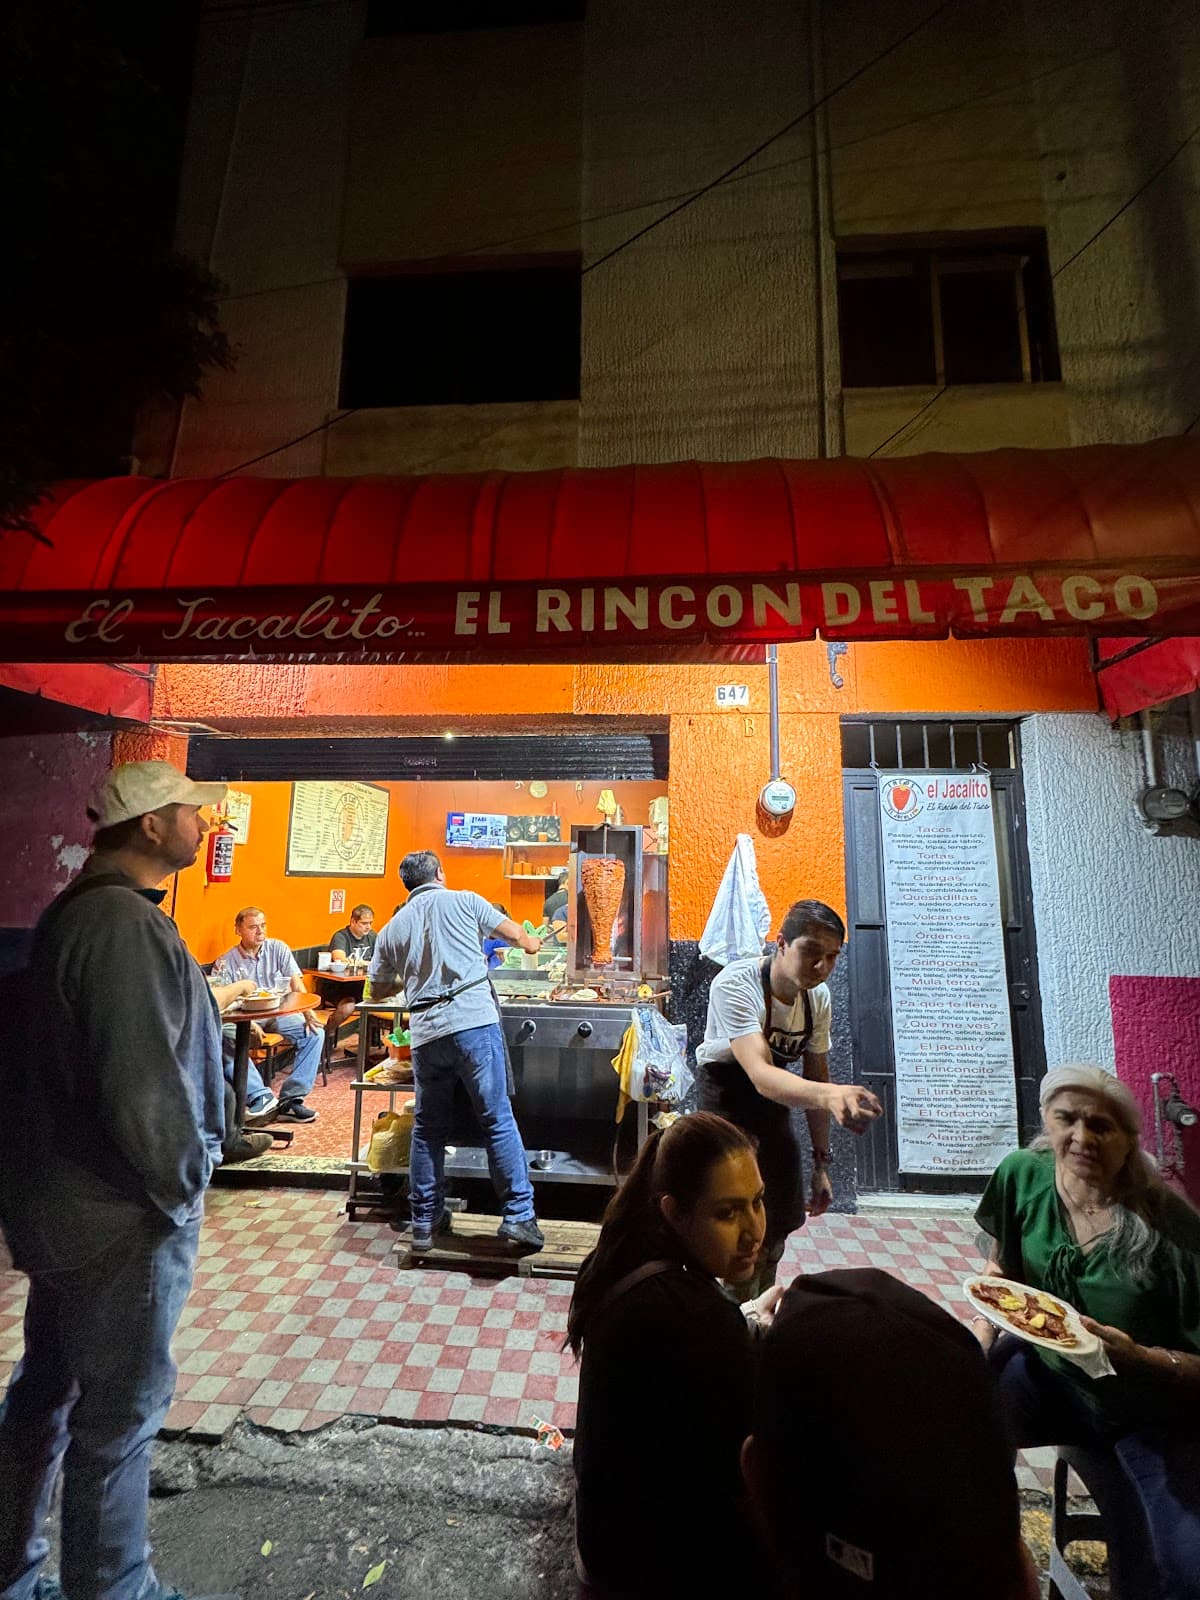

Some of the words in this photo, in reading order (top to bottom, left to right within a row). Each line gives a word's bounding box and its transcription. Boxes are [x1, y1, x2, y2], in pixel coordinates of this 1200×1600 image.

[63, 600, 134, 643] El
[455, 590, 510, 635] EL
[536, 582, 798, 634] RINCON
[822, 581, 937, 626] DEL
[952, 575, 1159, 623] TACO
[717, 686, 747, 700] 647
[927, 779, 938, 798] el
[942, 779, 988, 798] Jacalito
[927, 802, 935, 810] El
[960, 802, 971, 810] del
[972, 802, 991, 810] Taco
[913, 874, 962, 882] Gringas
[911, 959, 978, 967] Gringocha
[936, 1043, 984, 1051] jacalito
[931, 1065, 994, 1074] rinconcito
[927, 1133, 991, 1142] Alambres
[933, 1156, 986, 1165] Bebidas
